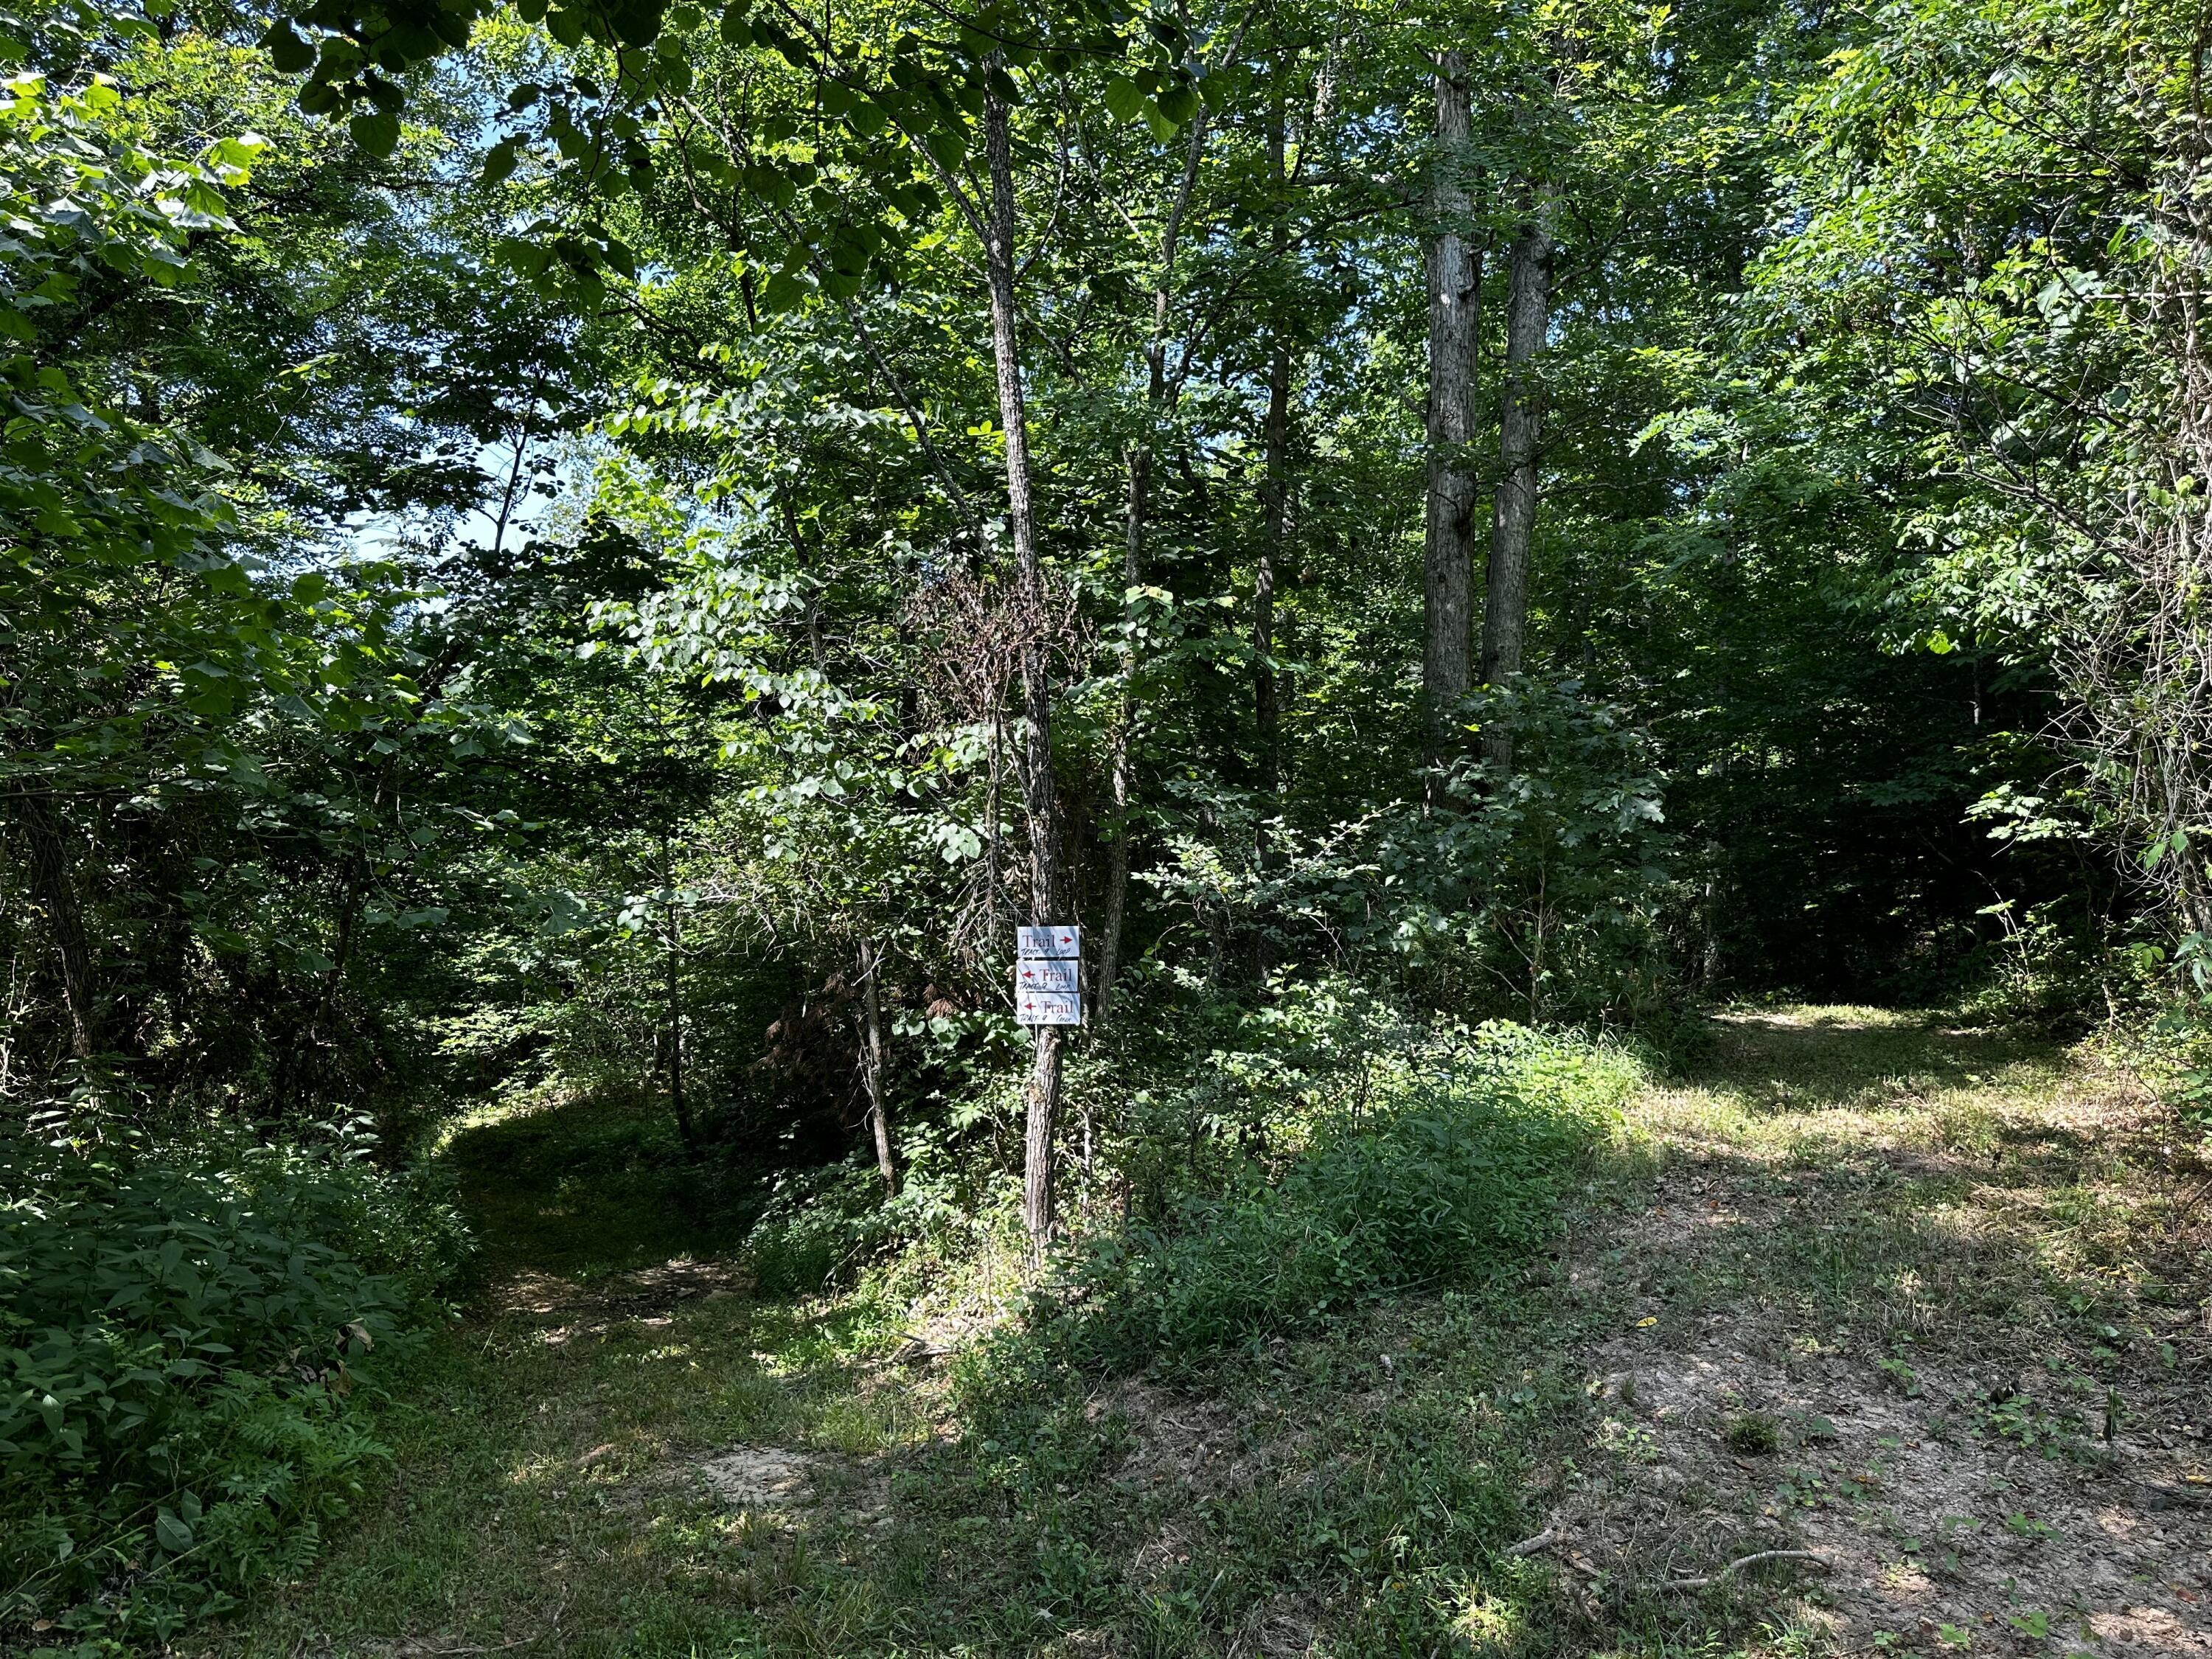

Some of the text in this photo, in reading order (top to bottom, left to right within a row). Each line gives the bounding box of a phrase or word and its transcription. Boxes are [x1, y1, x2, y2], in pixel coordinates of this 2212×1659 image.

[1022, 934, 1056, 947] Trail
[1056, 947, 1071, 956] LOOP
[1039, 968, 1072, 981] Trail
[1040, 1000, 1074, 1014] Trail
